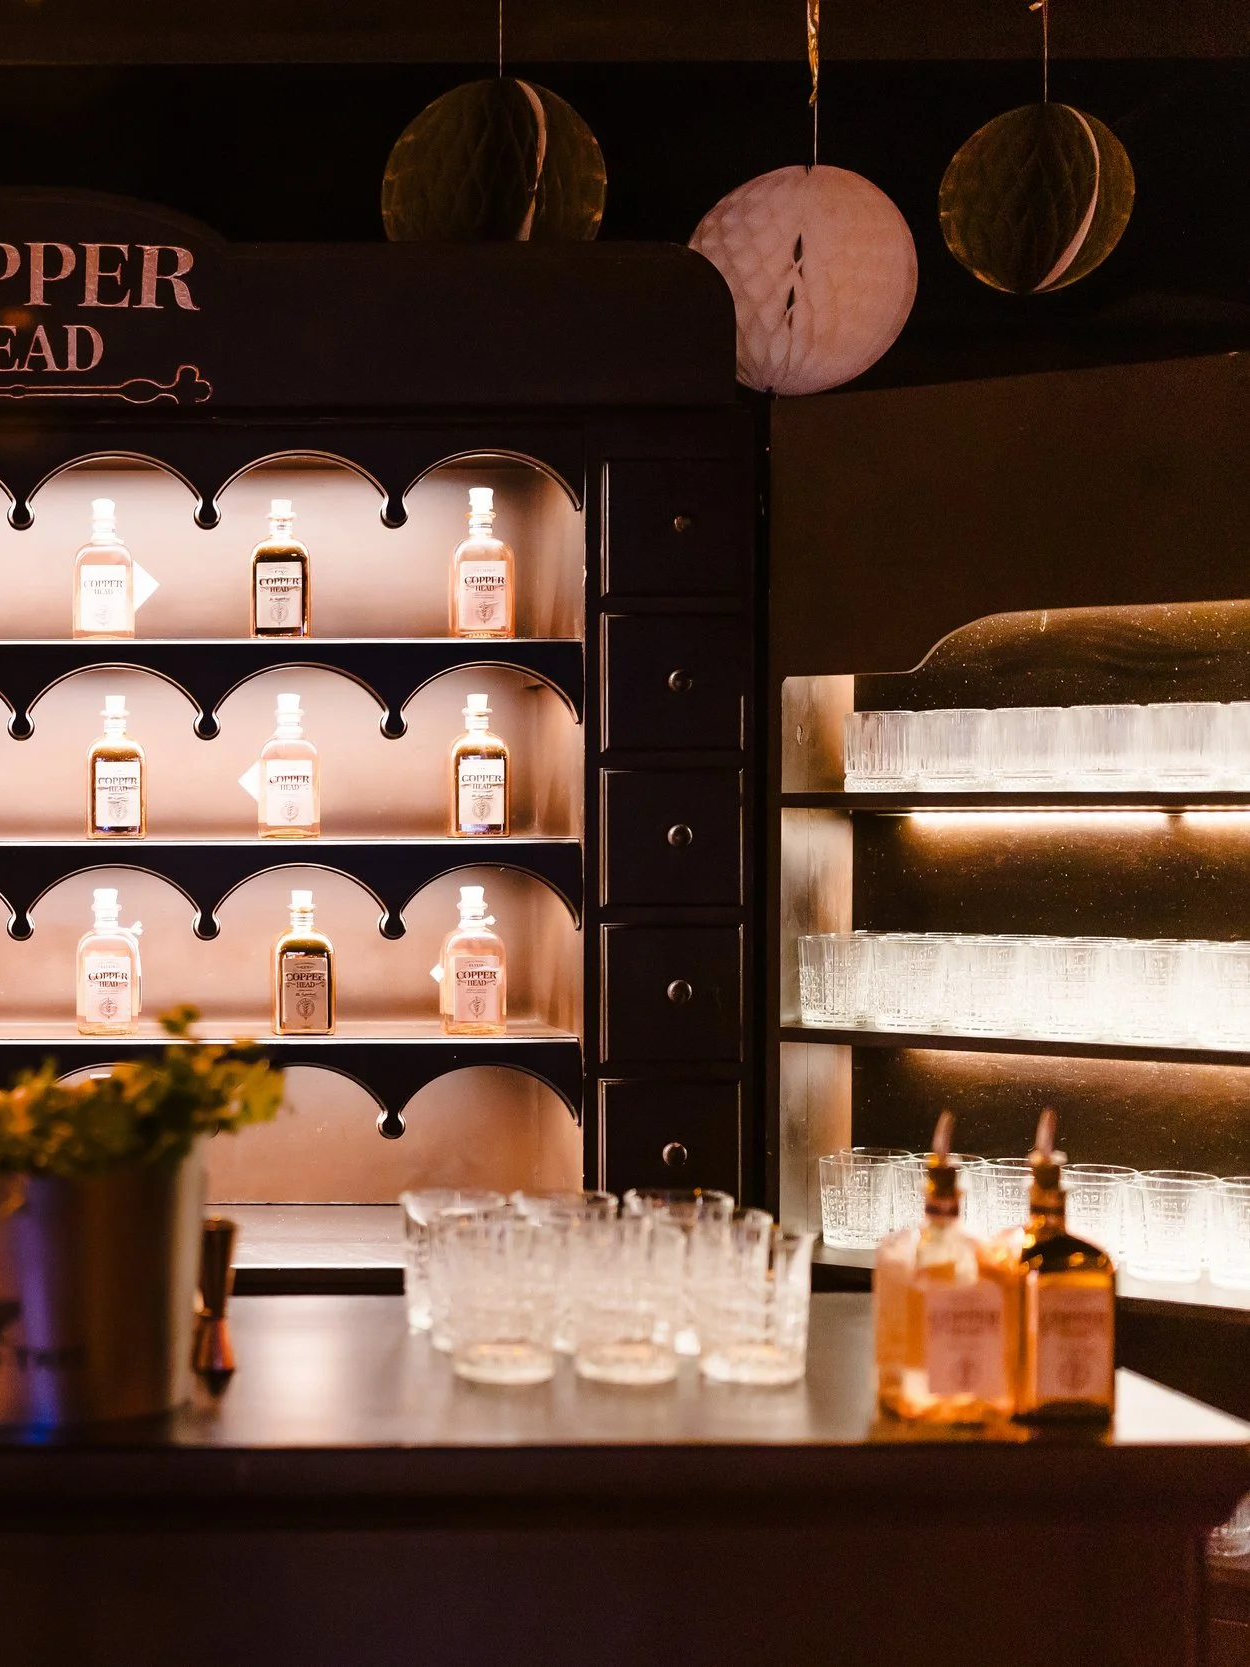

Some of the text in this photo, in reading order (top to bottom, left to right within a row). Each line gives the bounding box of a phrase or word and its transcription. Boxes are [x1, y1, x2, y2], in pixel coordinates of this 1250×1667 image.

[259, 577, 299, 586] COPPER
[464, 576, 505, 584] COPPER
[98, 776, 138, 785] COPPER
[269, 775, 310, 784] COPPER
[461, 774, 502, 783] COPPER
[88, 971, 128, 980] COPPER
[286, 972, 325, 981] COPPER
[456, 970, 497, 979] COPPER
[99, 980, 119, 988] HEAD
